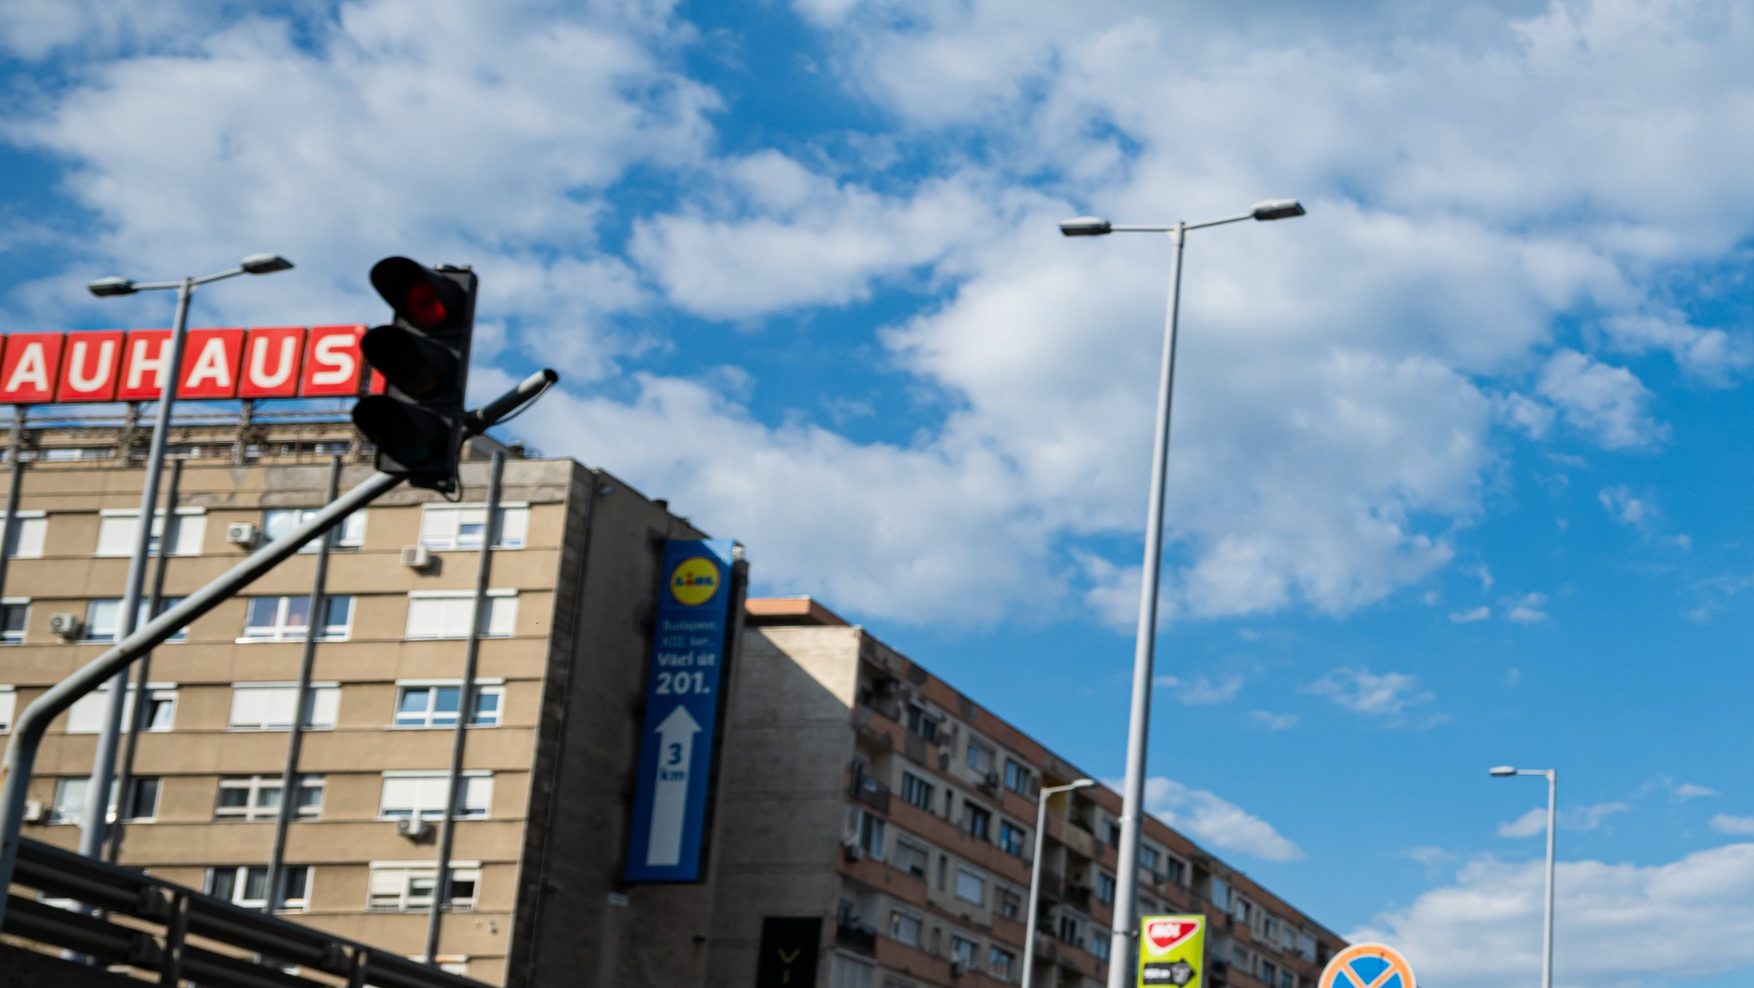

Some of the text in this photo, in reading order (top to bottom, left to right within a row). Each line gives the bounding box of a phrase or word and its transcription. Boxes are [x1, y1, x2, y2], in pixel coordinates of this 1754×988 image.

[4, 334, 356, 393] AUHAUS
[655, 671, 711, 695] 201.
[667, 742, 683, 765] 3
